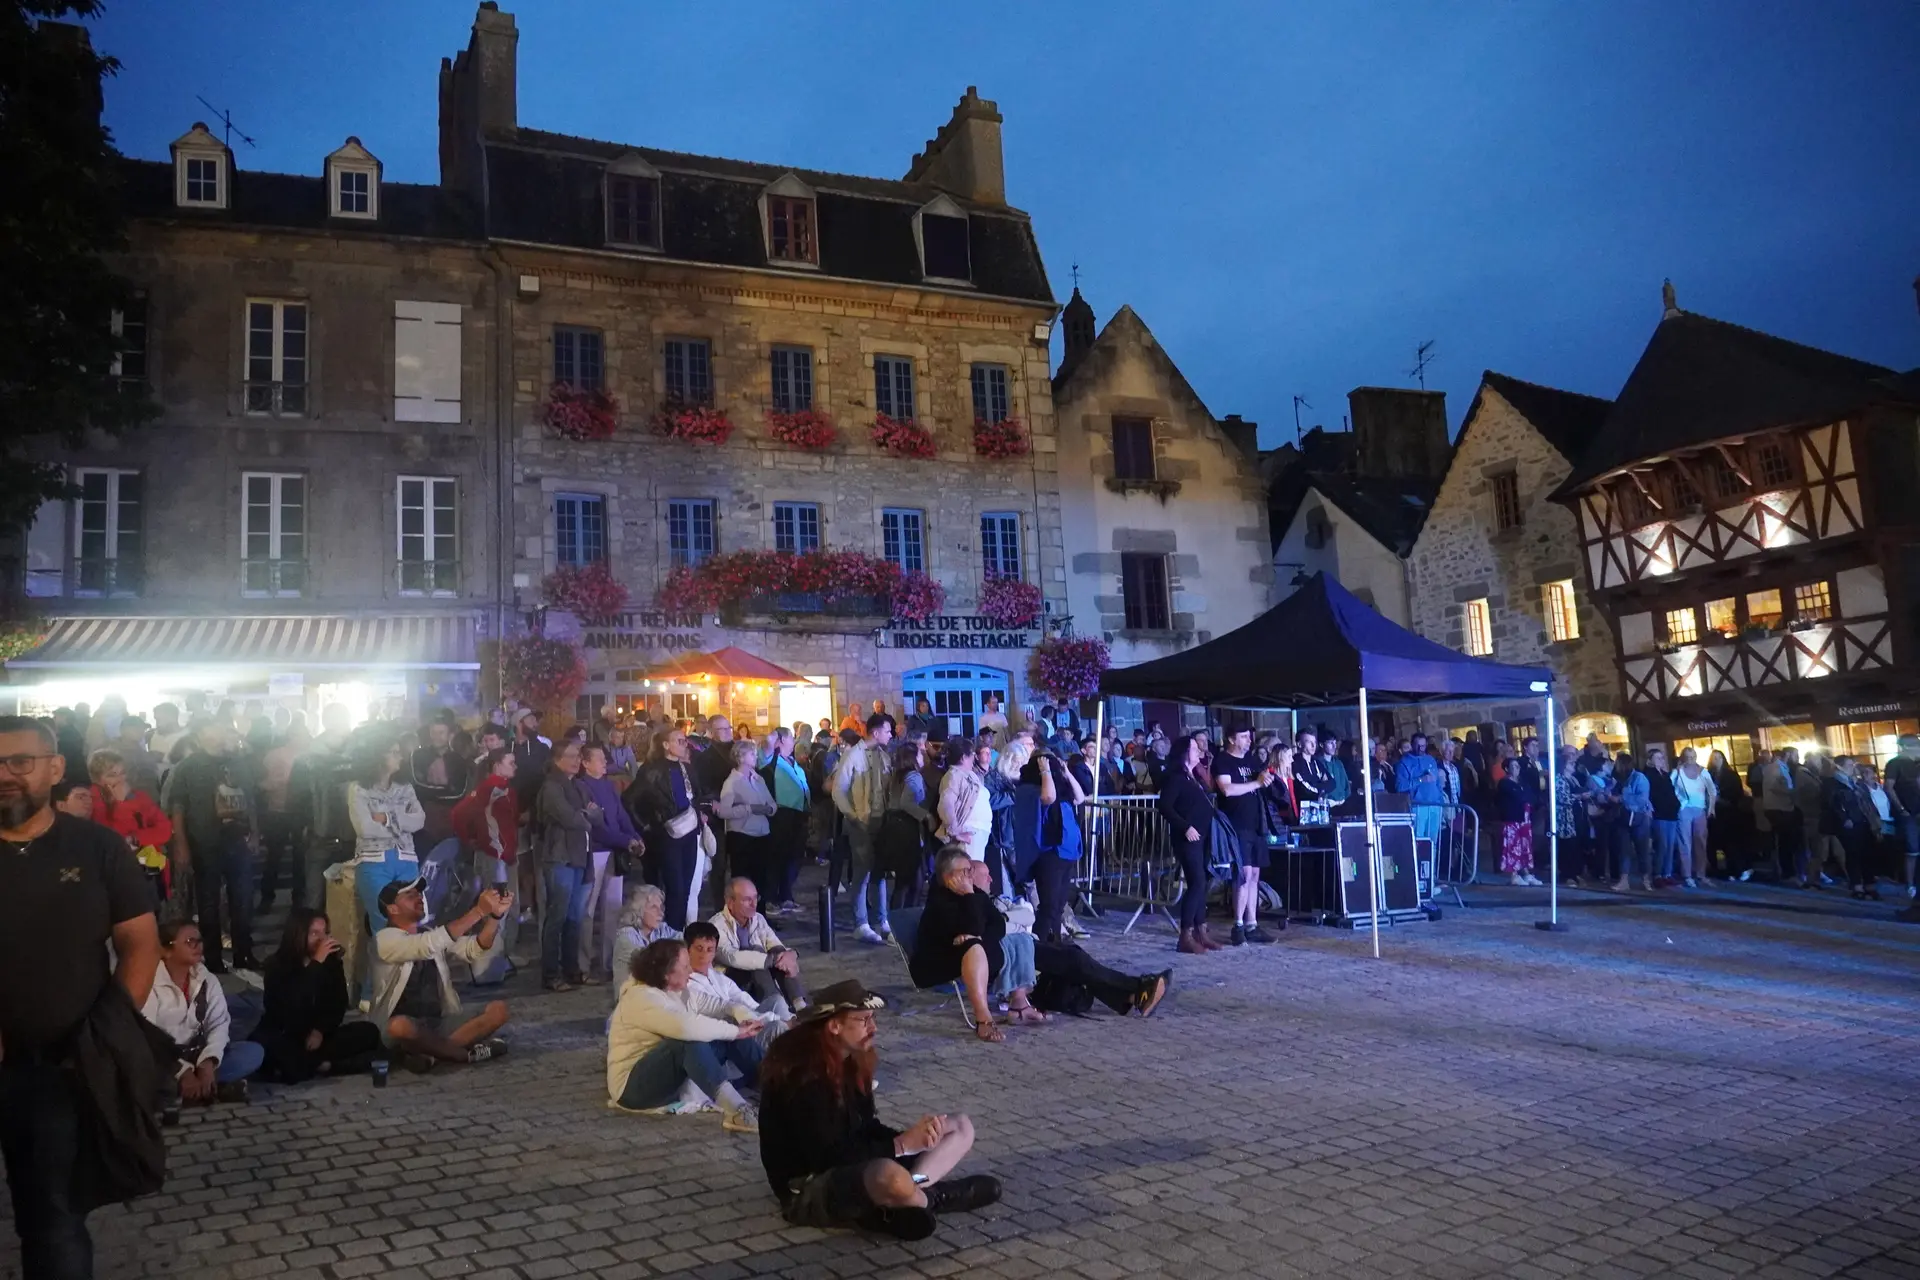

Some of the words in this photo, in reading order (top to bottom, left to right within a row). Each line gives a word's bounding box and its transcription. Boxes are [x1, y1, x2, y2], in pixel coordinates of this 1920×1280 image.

[938, 615, 960, 630] DE
[961, 615, 1041, 630] TOURME
[583, 632, 705, 650] ANIMATIONS
[893, 632, 947, 649] IROISE
[949, 632, 1029, 649] BRETAGNE
[1838, 702, 1901, 717] Restaurant
